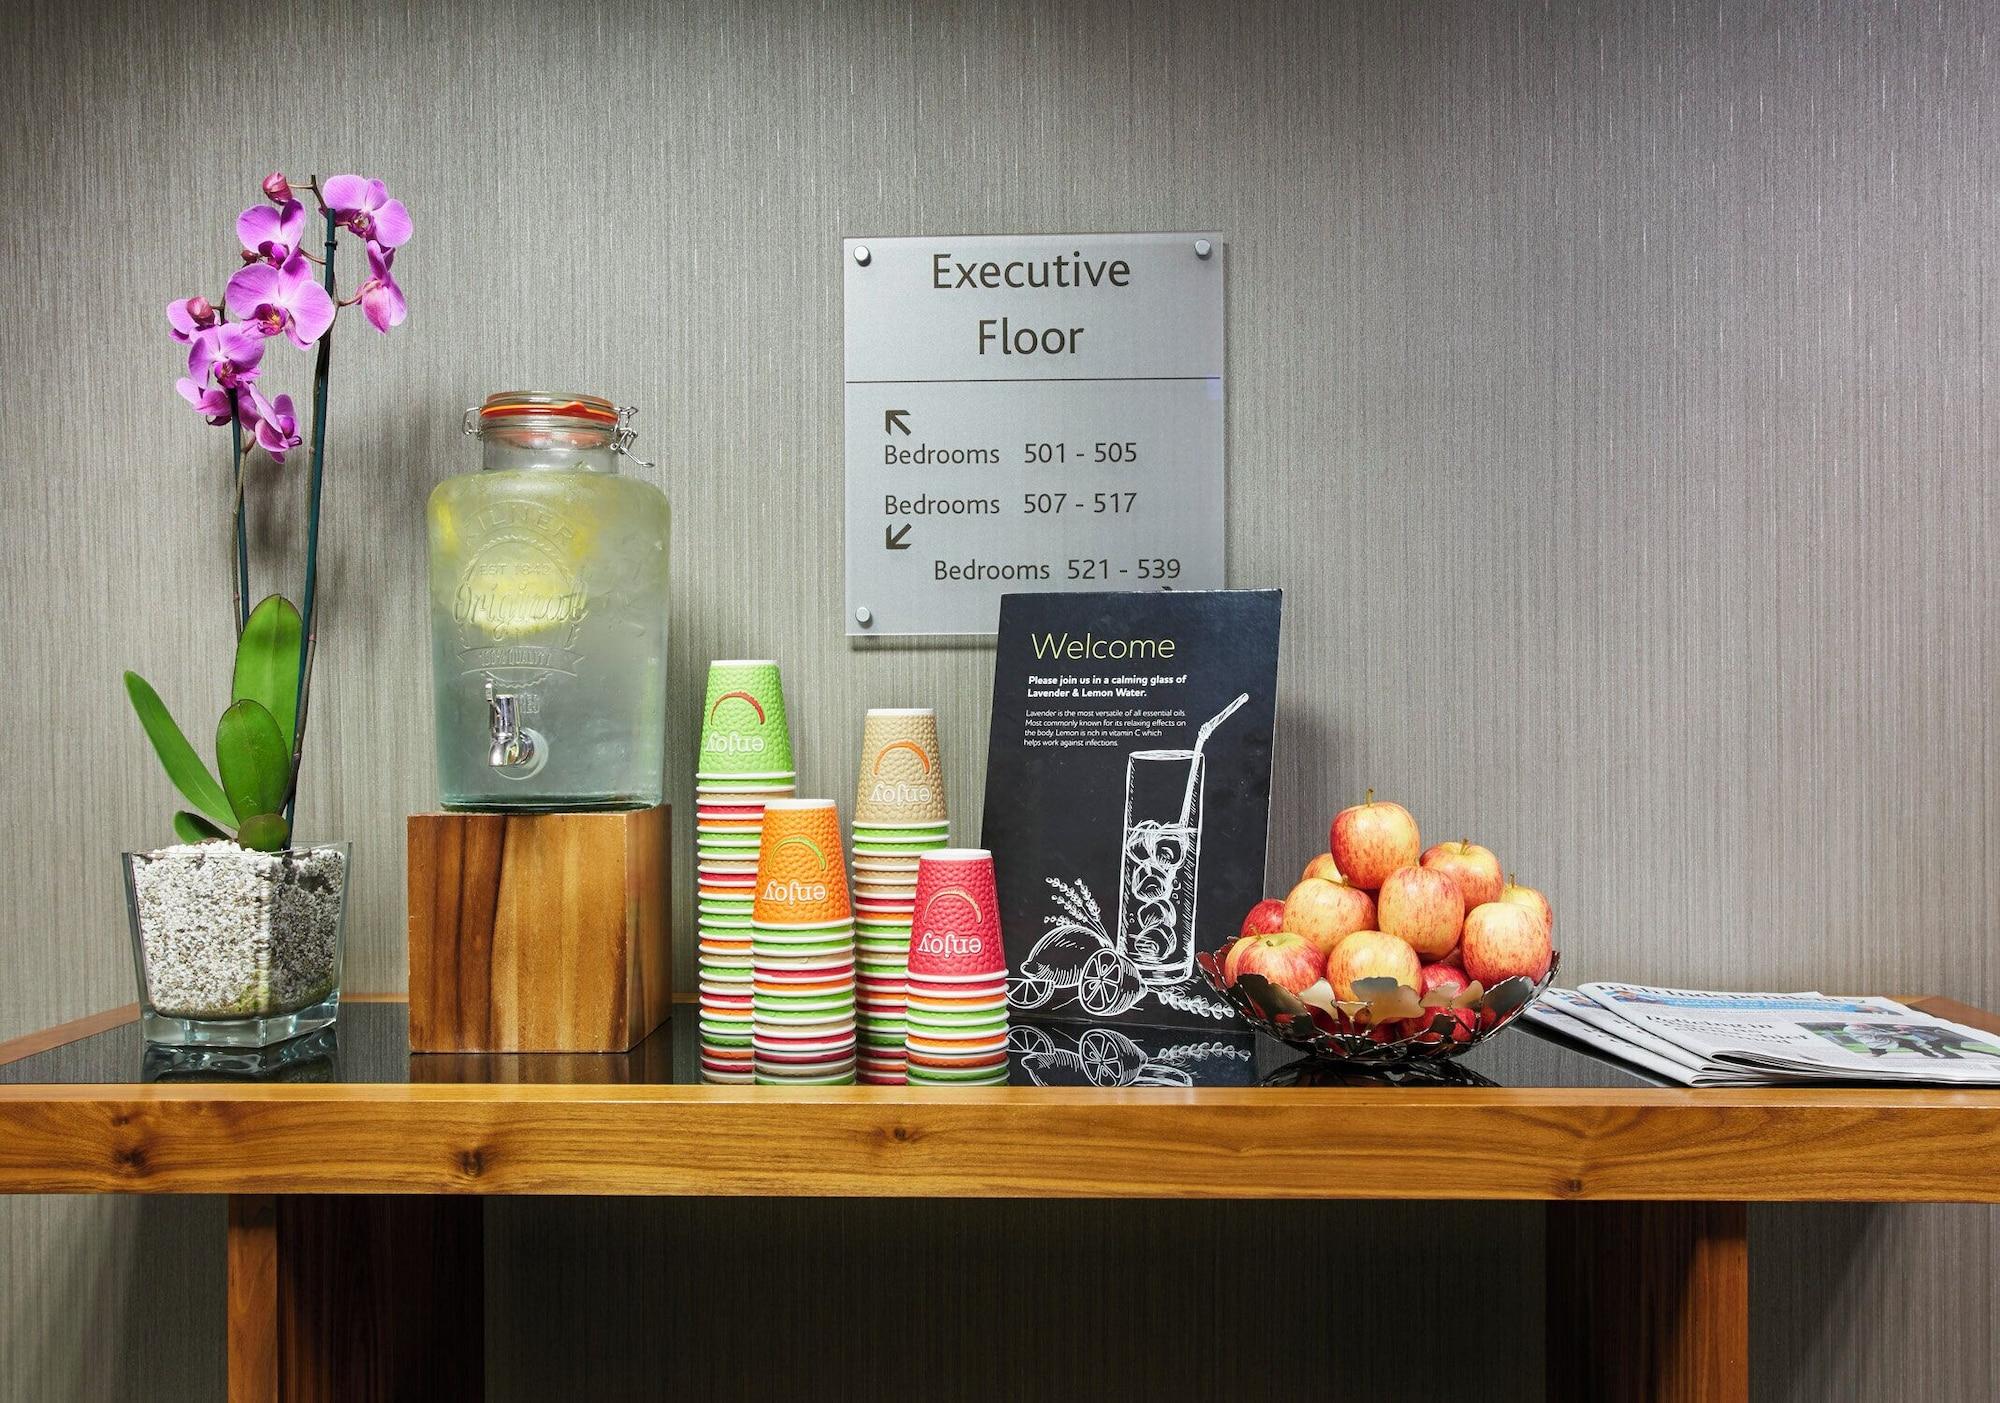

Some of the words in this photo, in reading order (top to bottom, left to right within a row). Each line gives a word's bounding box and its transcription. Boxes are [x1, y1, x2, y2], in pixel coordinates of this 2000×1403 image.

[933, 250, 1131, 289] Executive
[979, 316, 1085, 355] Floor
[885, 442, 1000, 465] Bedrooms
[1024, 442, 1066, 464] 501
[1094, 441, 1137, 463] 505
[885, 493, 1000, 515] Bedrooms
[1023, 492, 1068, 514] 507
[1093, 492, 1138, 514] 517
[935, 558, 1050, 581] Bedrooms
[1067, 558, 1108, 580] 521
[1137, 558, 1181, 580] 539
[452, 578, 590, 642] Original
[508, 647, 554, 667] QUALITY
[1031, 632, 1176, 660] Welcome
[1028, 675, 1058, 685] Please
[1059, 674, 1078, 687] join
[1079, 677, 1091, 685] us
[1092, 674, 1102, 684] in
[1111, 674, 1148, 687] calming
[1150, 674, 1174, 687] glass
[1175, 674, 1188, 684] of
[1027, 688, 1070, 698] Lavender
[1072, 688, 1080, 698] &
[1081, 688, 1113, 698] Lemon
[1115, 687, 1147, 697] Water.
[1025, 709, 1057, 717] Lavender
[1057, 709, 1064, 717] is
[1064, 709, 1076, 717] the
[1095, 709, 1123, 717] versatile
[1124, 708, 1134, 717] of
[1133, 709, 1142, 717] all
[1142, 709, 1172, 717] essential
[1025, 719, 1042, 727] Most
[1043, 719, 1079, 729] commonly
[1079, 719, 1102, 727] known
[1102, 718, 1114, 727] for
[1114, 719, 1123, 727] its
[1124, 719, 1151, 729] relaxing
[1151, 718, 1175, 727] effects
[705, 731, 765, 755] enjoy
[1023, 738, 1042, 748] helps
[1042, 738, 1060, 747] work
[1060, 739, 1084, 749] against
[1024, 729, 1036, 737] the
[1055, 729, 1080, 737] Lemon
[1080, 729, 1087, 737] is
[1087, 729, 1101, 737] rich
[1101, 729, 1108, 737] in
[1109, 729, 1134, 737] vitamin
[1134, 728, 1141, 737] C
[1142, 729, 1163, 737] which
[869, 781, 932, 808] enjoy
[762, 880, 827, 906] enjoy
[917, 931, 982, 958] enjoy
